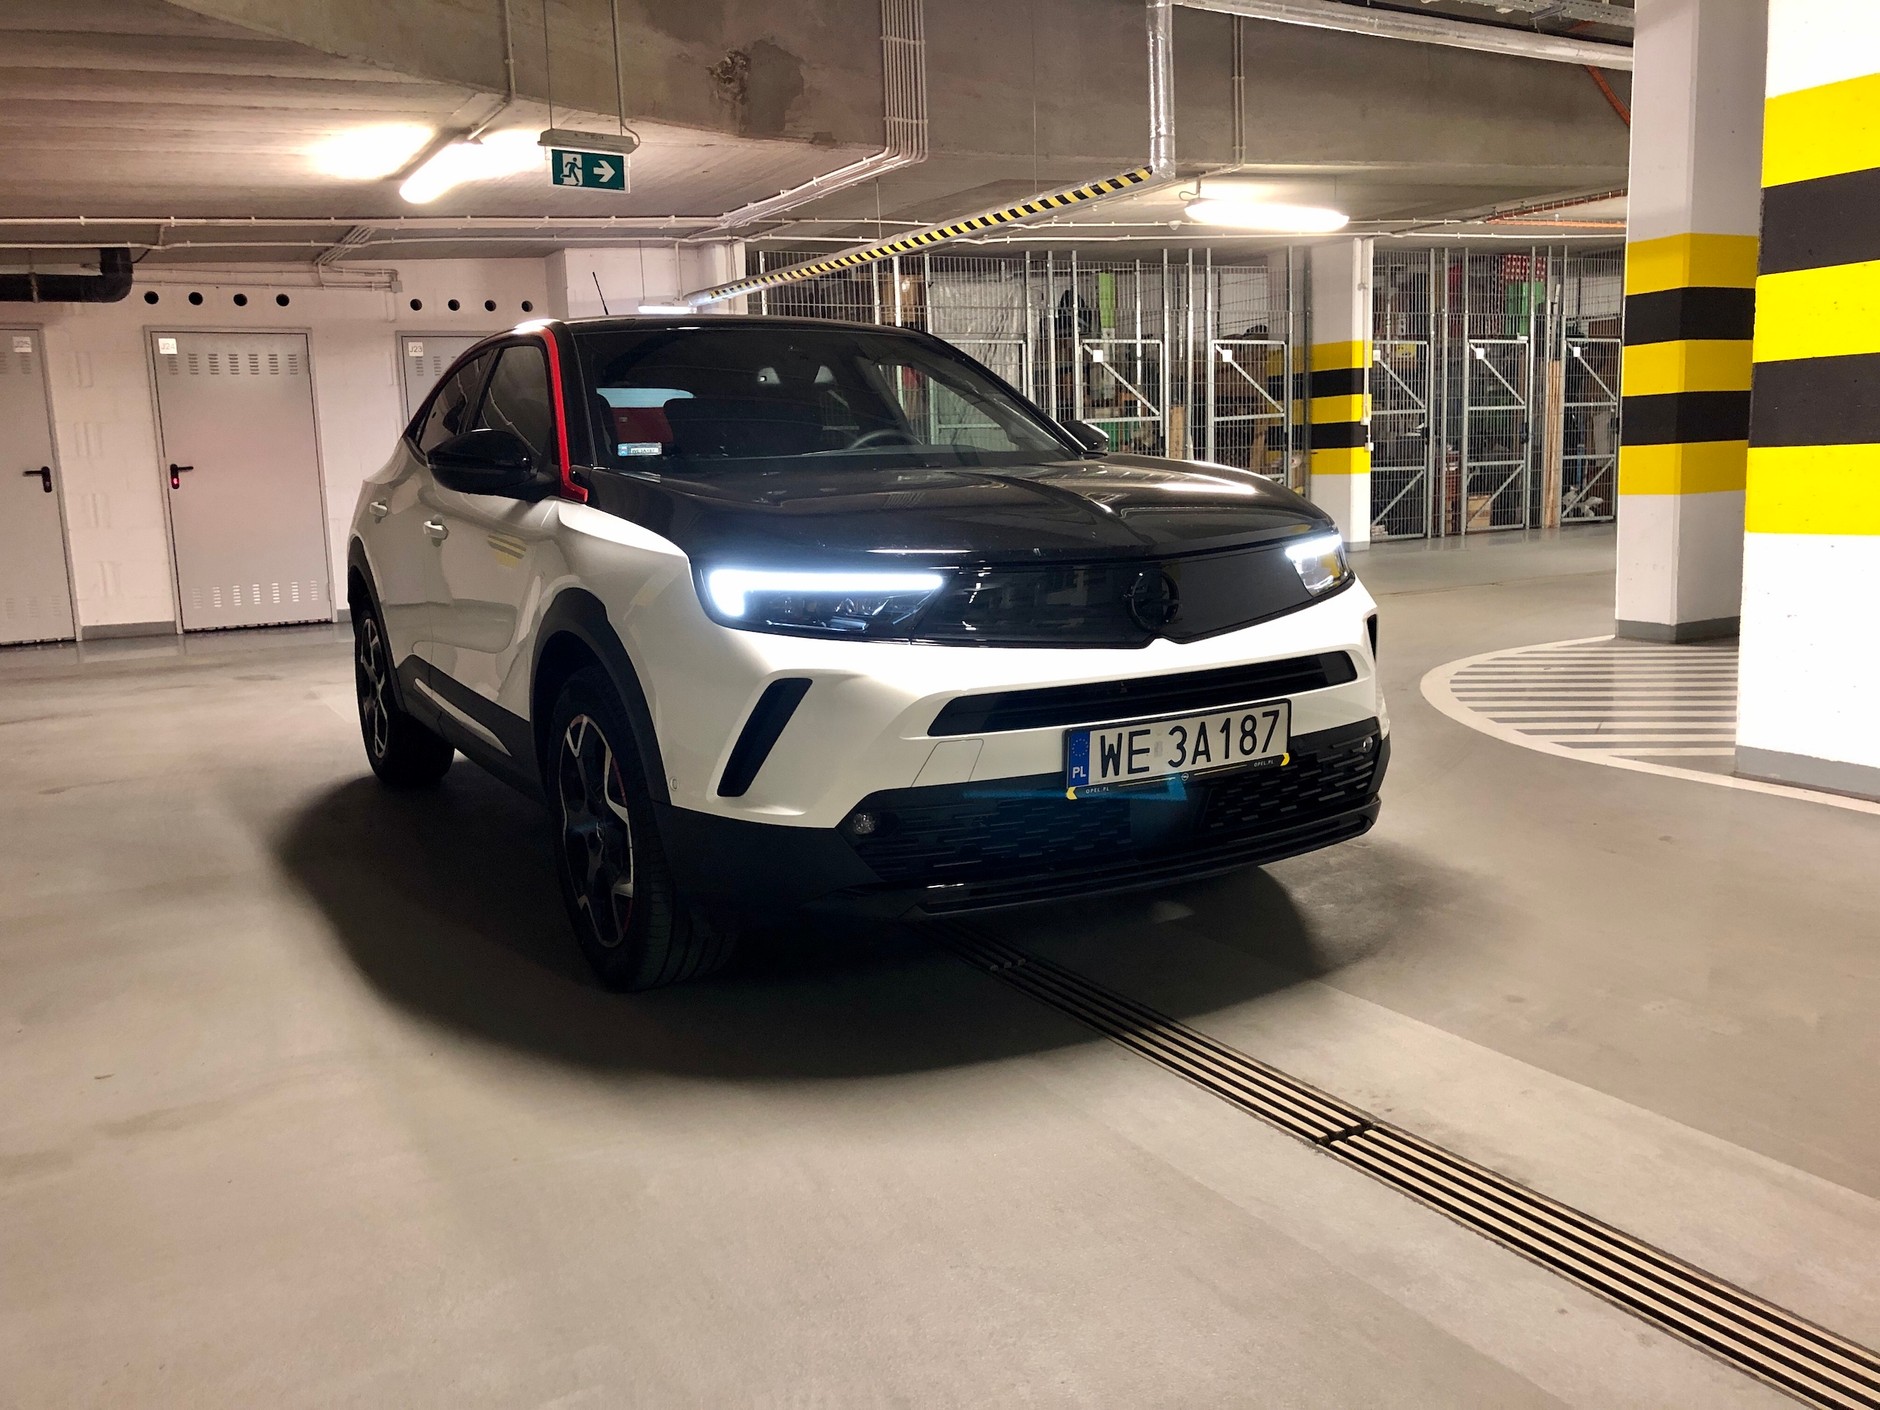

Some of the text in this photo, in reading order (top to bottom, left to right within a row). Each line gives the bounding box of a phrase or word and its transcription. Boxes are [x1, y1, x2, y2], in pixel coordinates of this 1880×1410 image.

[160, 342, 176, 350] J24
[409, 345, 423, 353] J23
[1100, 709, 1280, 778] WE 3A187
[1072, 766, 1086, 779] PL
